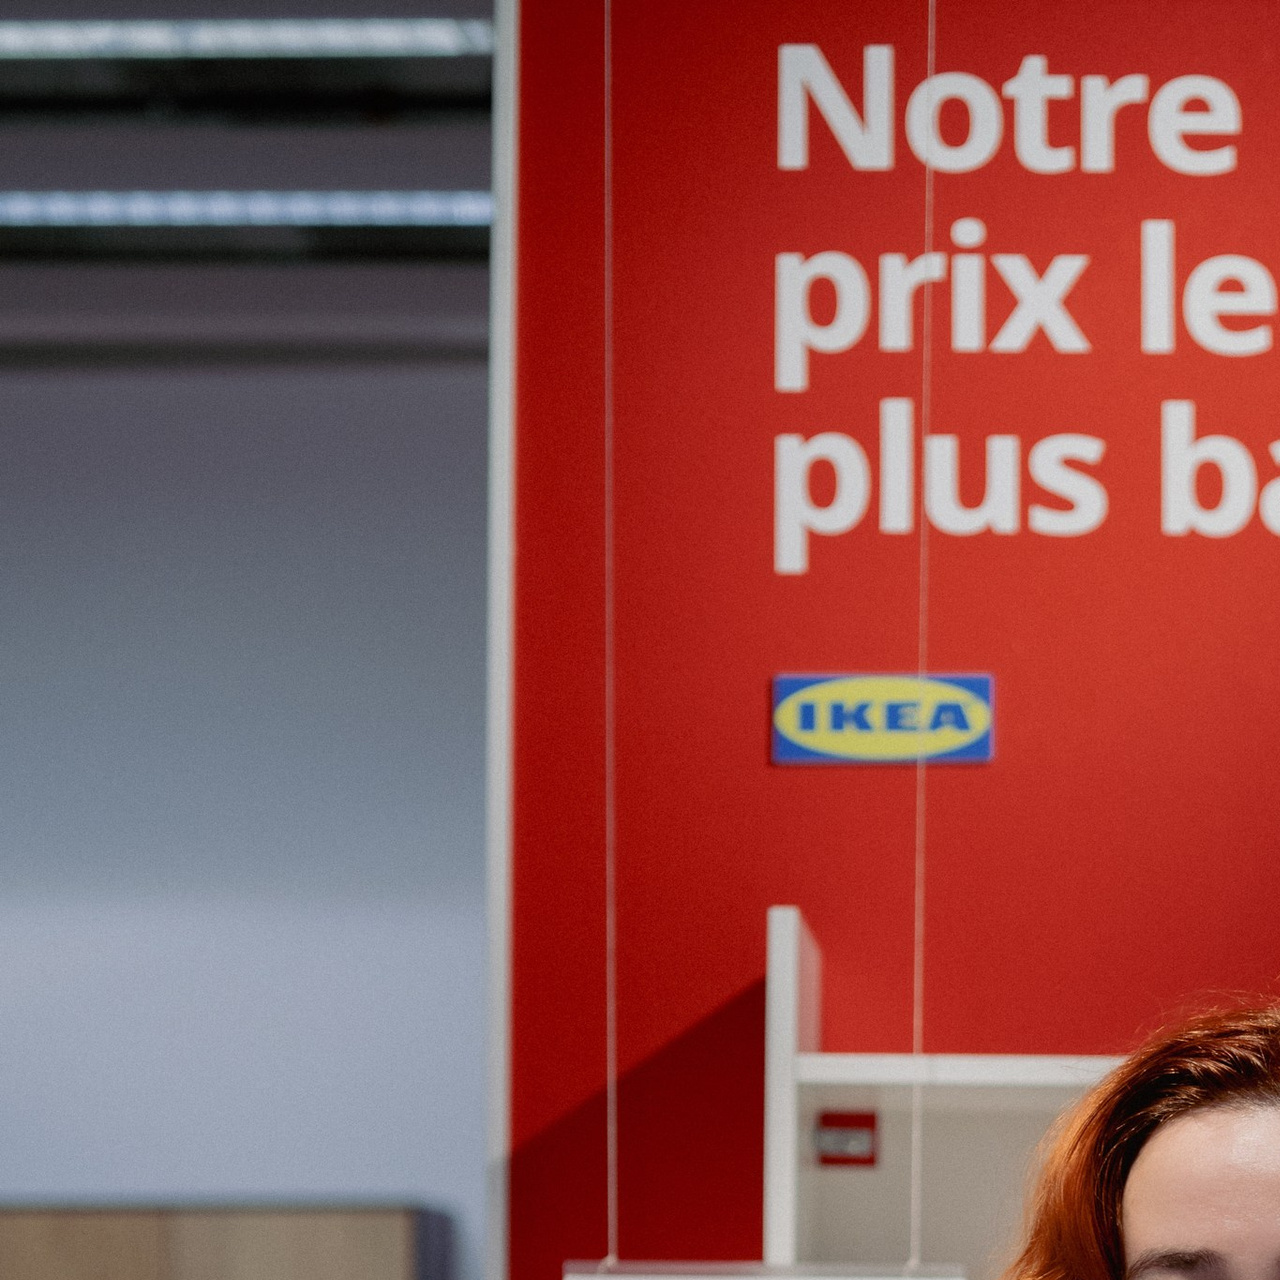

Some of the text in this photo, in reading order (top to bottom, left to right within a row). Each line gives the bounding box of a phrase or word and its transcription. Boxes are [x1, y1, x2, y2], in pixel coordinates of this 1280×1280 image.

[777, 44, 1242, 176] Notre
[774, 217, 1278, 393] prix le
[774, 397, 1109, 574] plus
[795, 701, 972, 733] IKEA
